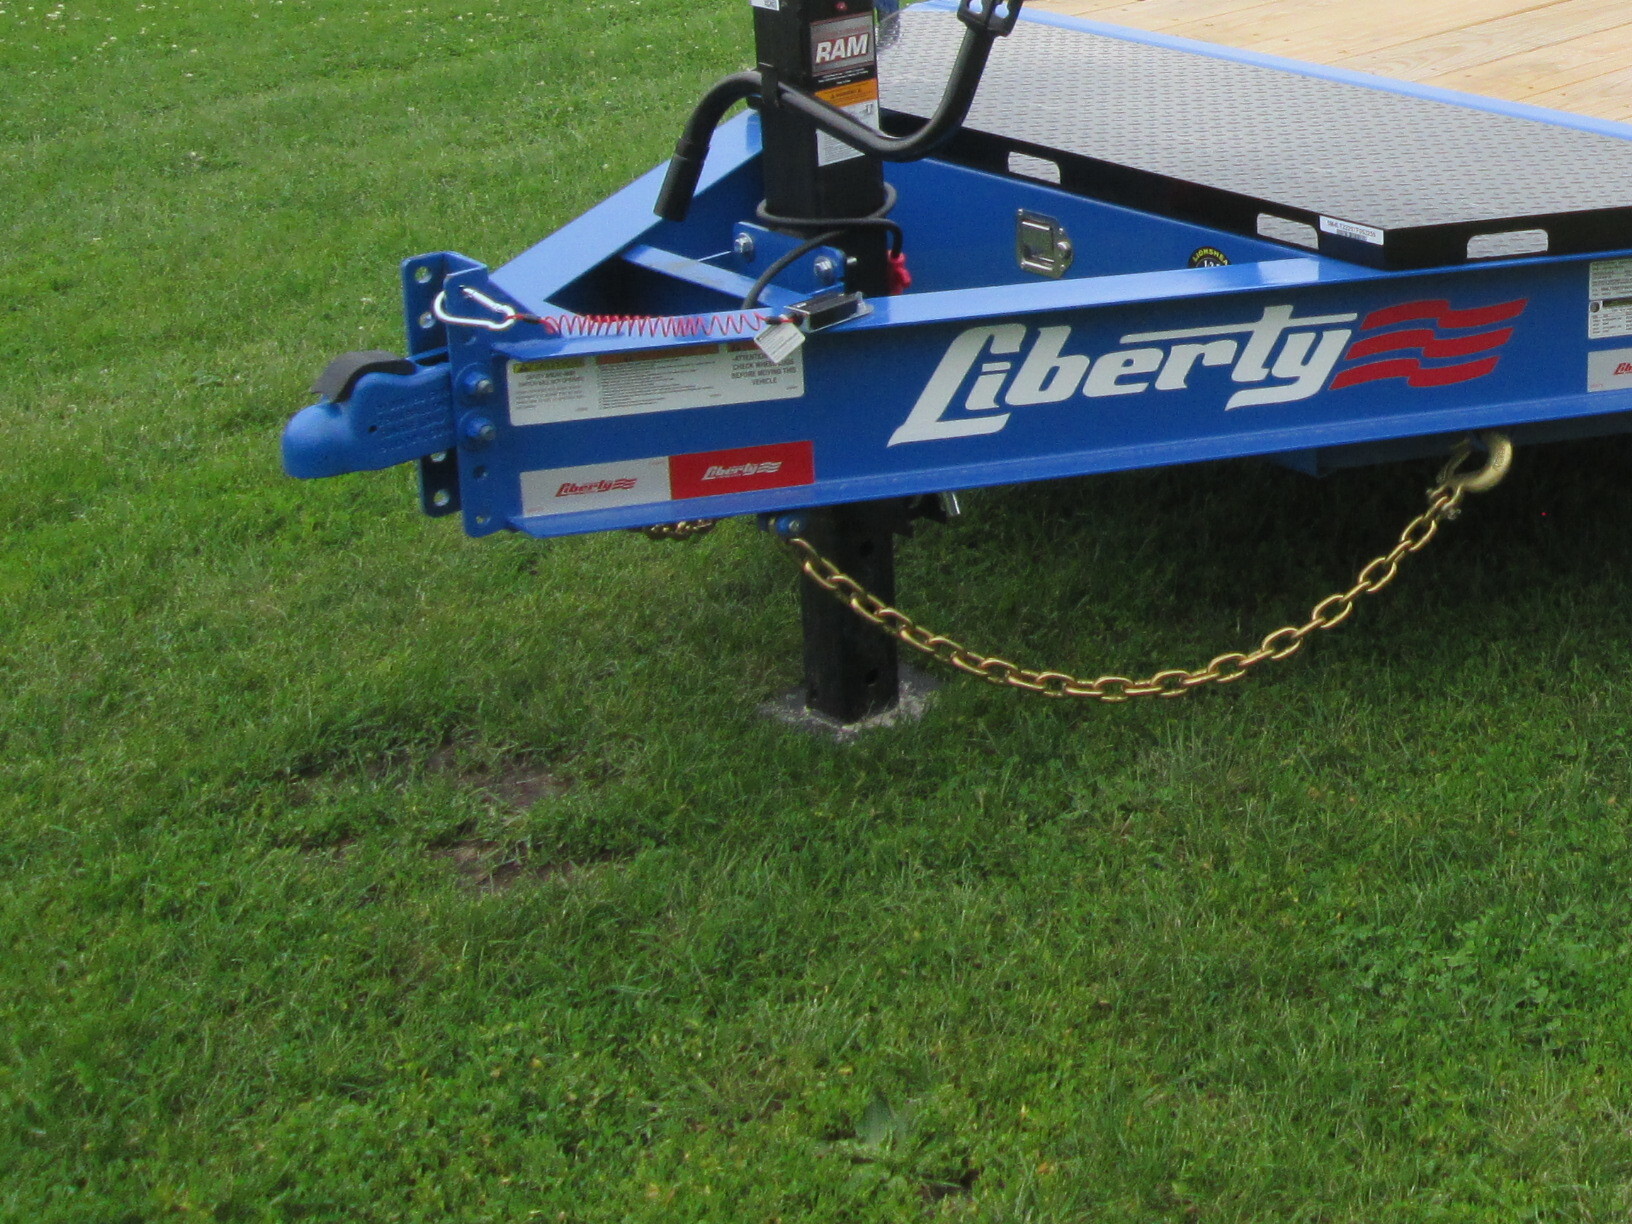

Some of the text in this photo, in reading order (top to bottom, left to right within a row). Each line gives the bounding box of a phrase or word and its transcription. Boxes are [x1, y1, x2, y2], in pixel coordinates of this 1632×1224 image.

[815, 33, 869, 65] RAM
[887, 304, 1357, 448] Liberty
[702, 463, 759, 481] Liberty
[555, 480, 613, 498] Liberty
